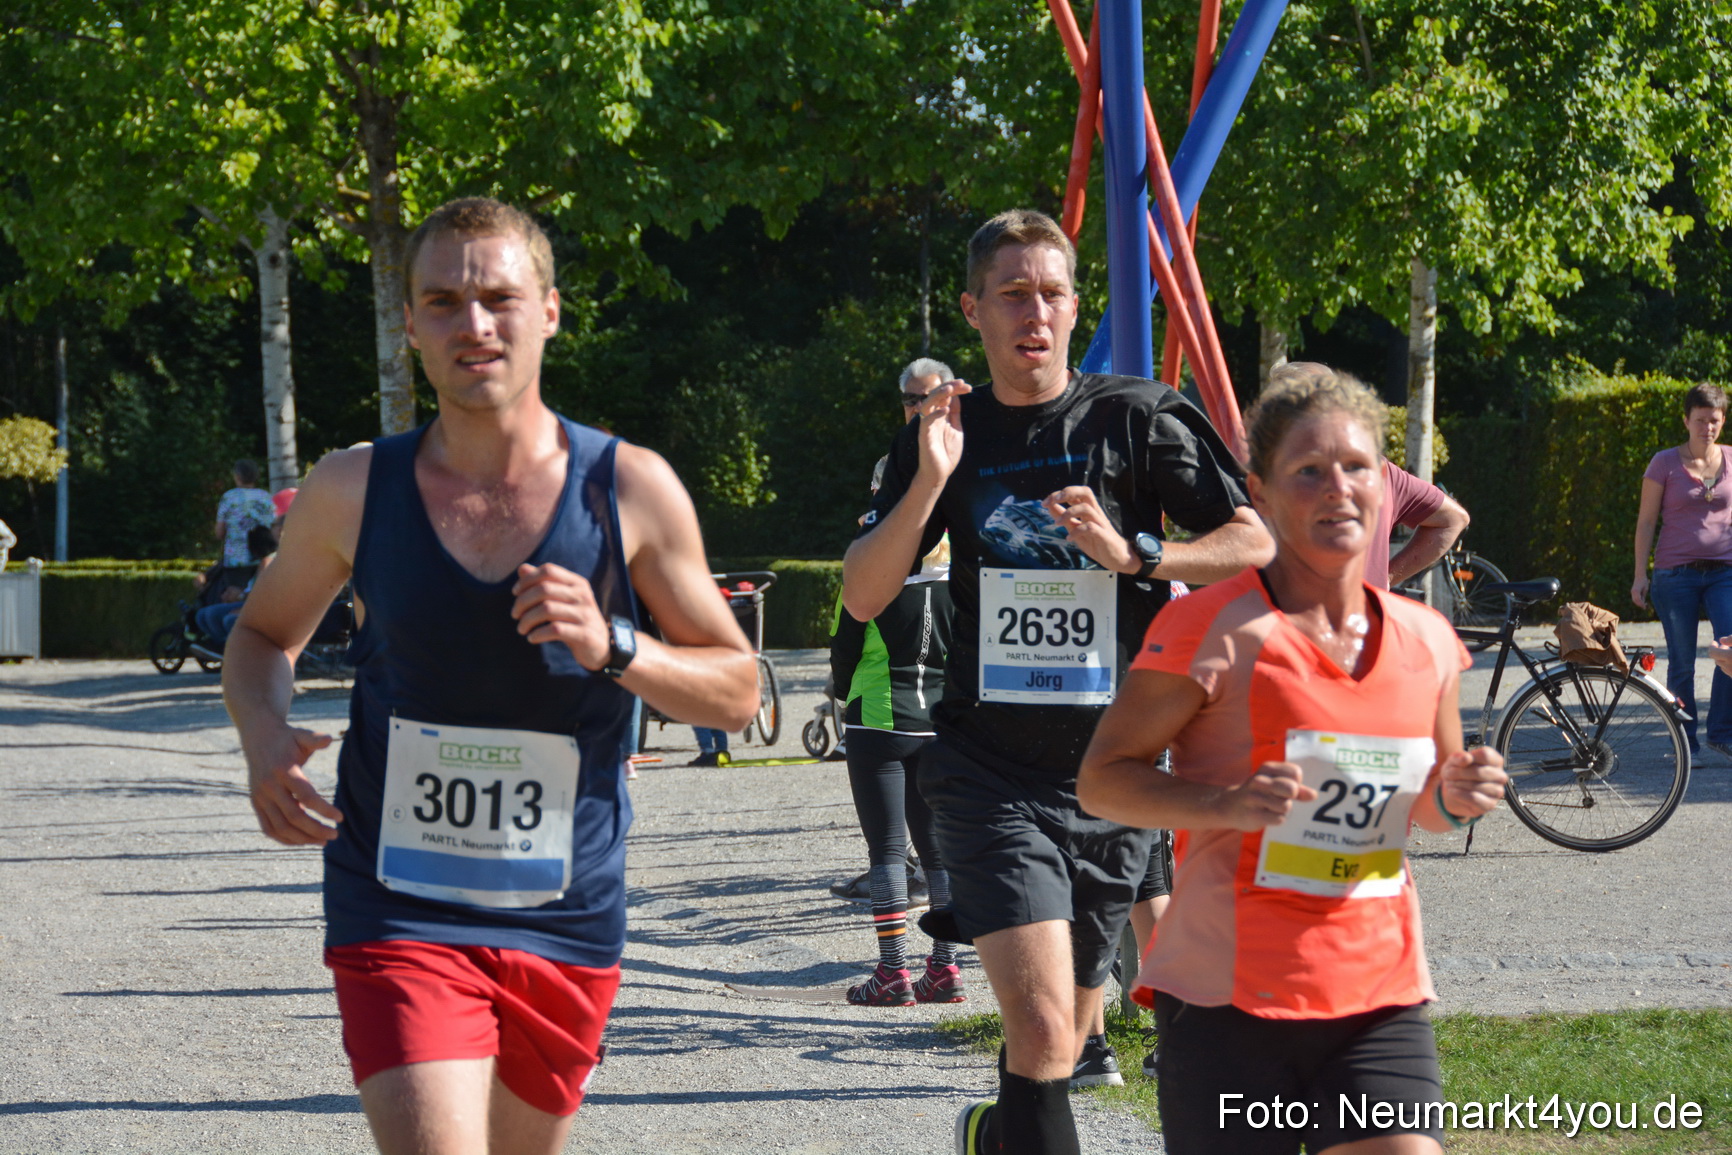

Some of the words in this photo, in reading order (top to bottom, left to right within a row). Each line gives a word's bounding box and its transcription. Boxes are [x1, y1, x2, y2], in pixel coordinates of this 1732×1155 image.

[1015, 582, 1076, 596] BOCK
[998, 607, 1095, 647] 2639
[1006, 652, 1031, 661] PARTL
[1034, 653, 1075, 662] Neumarkt
[1025, 671, 1063, 692] Jörg
[440, 742, 522, 764] BOCK
[1336, 748, 1401, 769] BOCK
[413, 772, 543, 831] 3013
[1312, 779, 1399, 830] 237
[393, 809, 401, 819] C
[422, 832, 459, 847] PARTL
[461, 838, 515, 851] Neumarkt
[1303, 829, 1339, 844] PARTL
